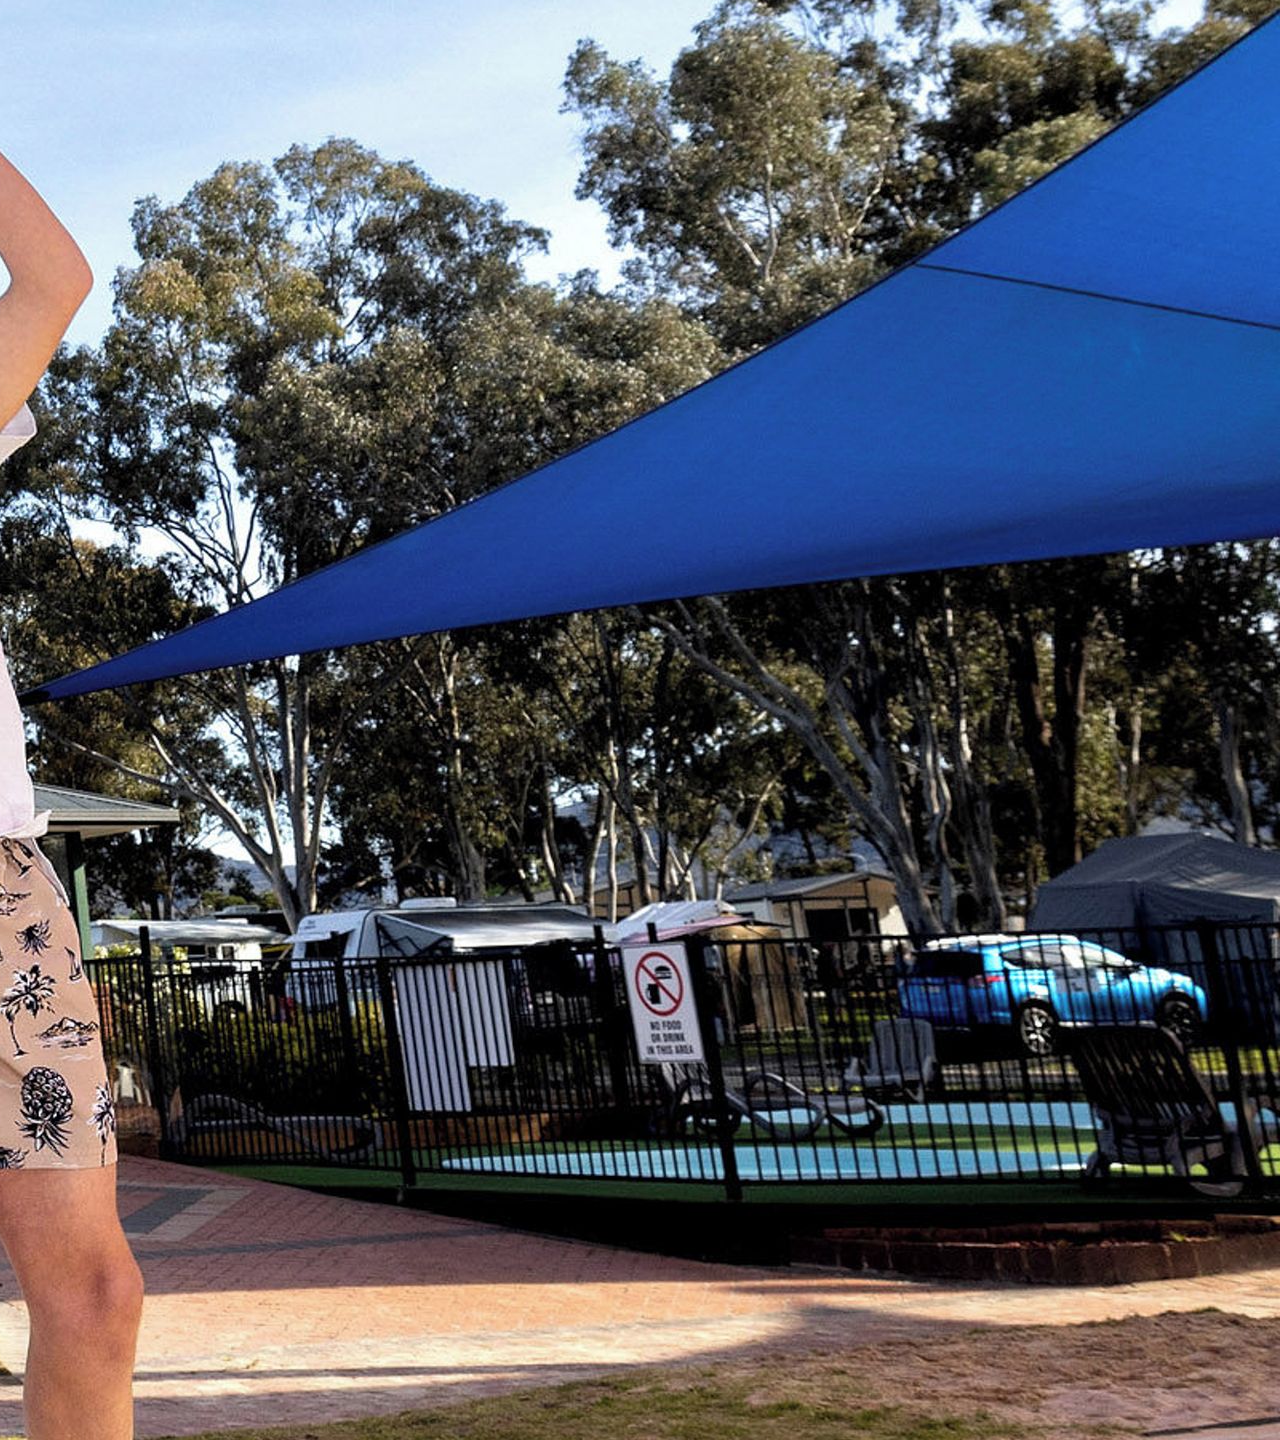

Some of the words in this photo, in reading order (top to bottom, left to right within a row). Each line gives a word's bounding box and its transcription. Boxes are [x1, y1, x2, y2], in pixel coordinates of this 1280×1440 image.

[650, 1021, 660, 1030] NO
[662, 1020, 682, 1030] FOOD
[651, 1033, 660, 1043] OR
[662, 1032, 685, 1042] DRINK
[647, 1046, 654, 1054] IN
[656, 1045, 673, 1054] THIS
[675, 1045, 694, 1054] AREA
